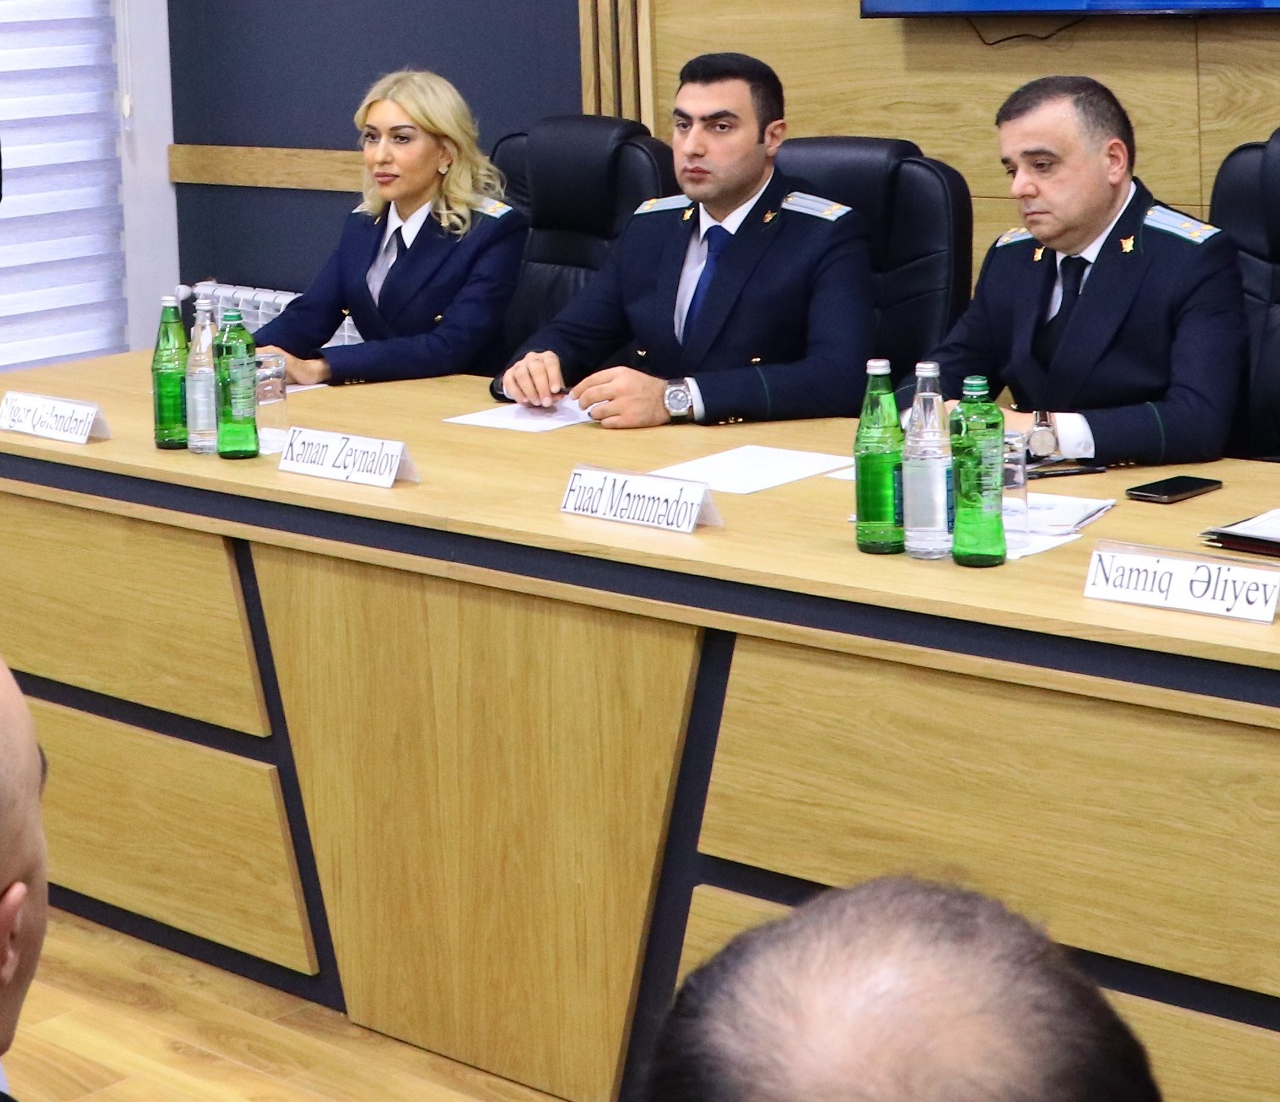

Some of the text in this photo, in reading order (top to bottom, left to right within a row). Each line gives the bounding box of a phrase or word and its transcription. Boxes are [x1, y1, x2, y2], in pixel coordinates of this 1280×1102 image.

[284, 429, 399, 481] Kənan Zeynalov
[561, 472, 700, 531] Fuad Məmmədov
[1091, 553, 1278, 613] Namiq Əliyev
